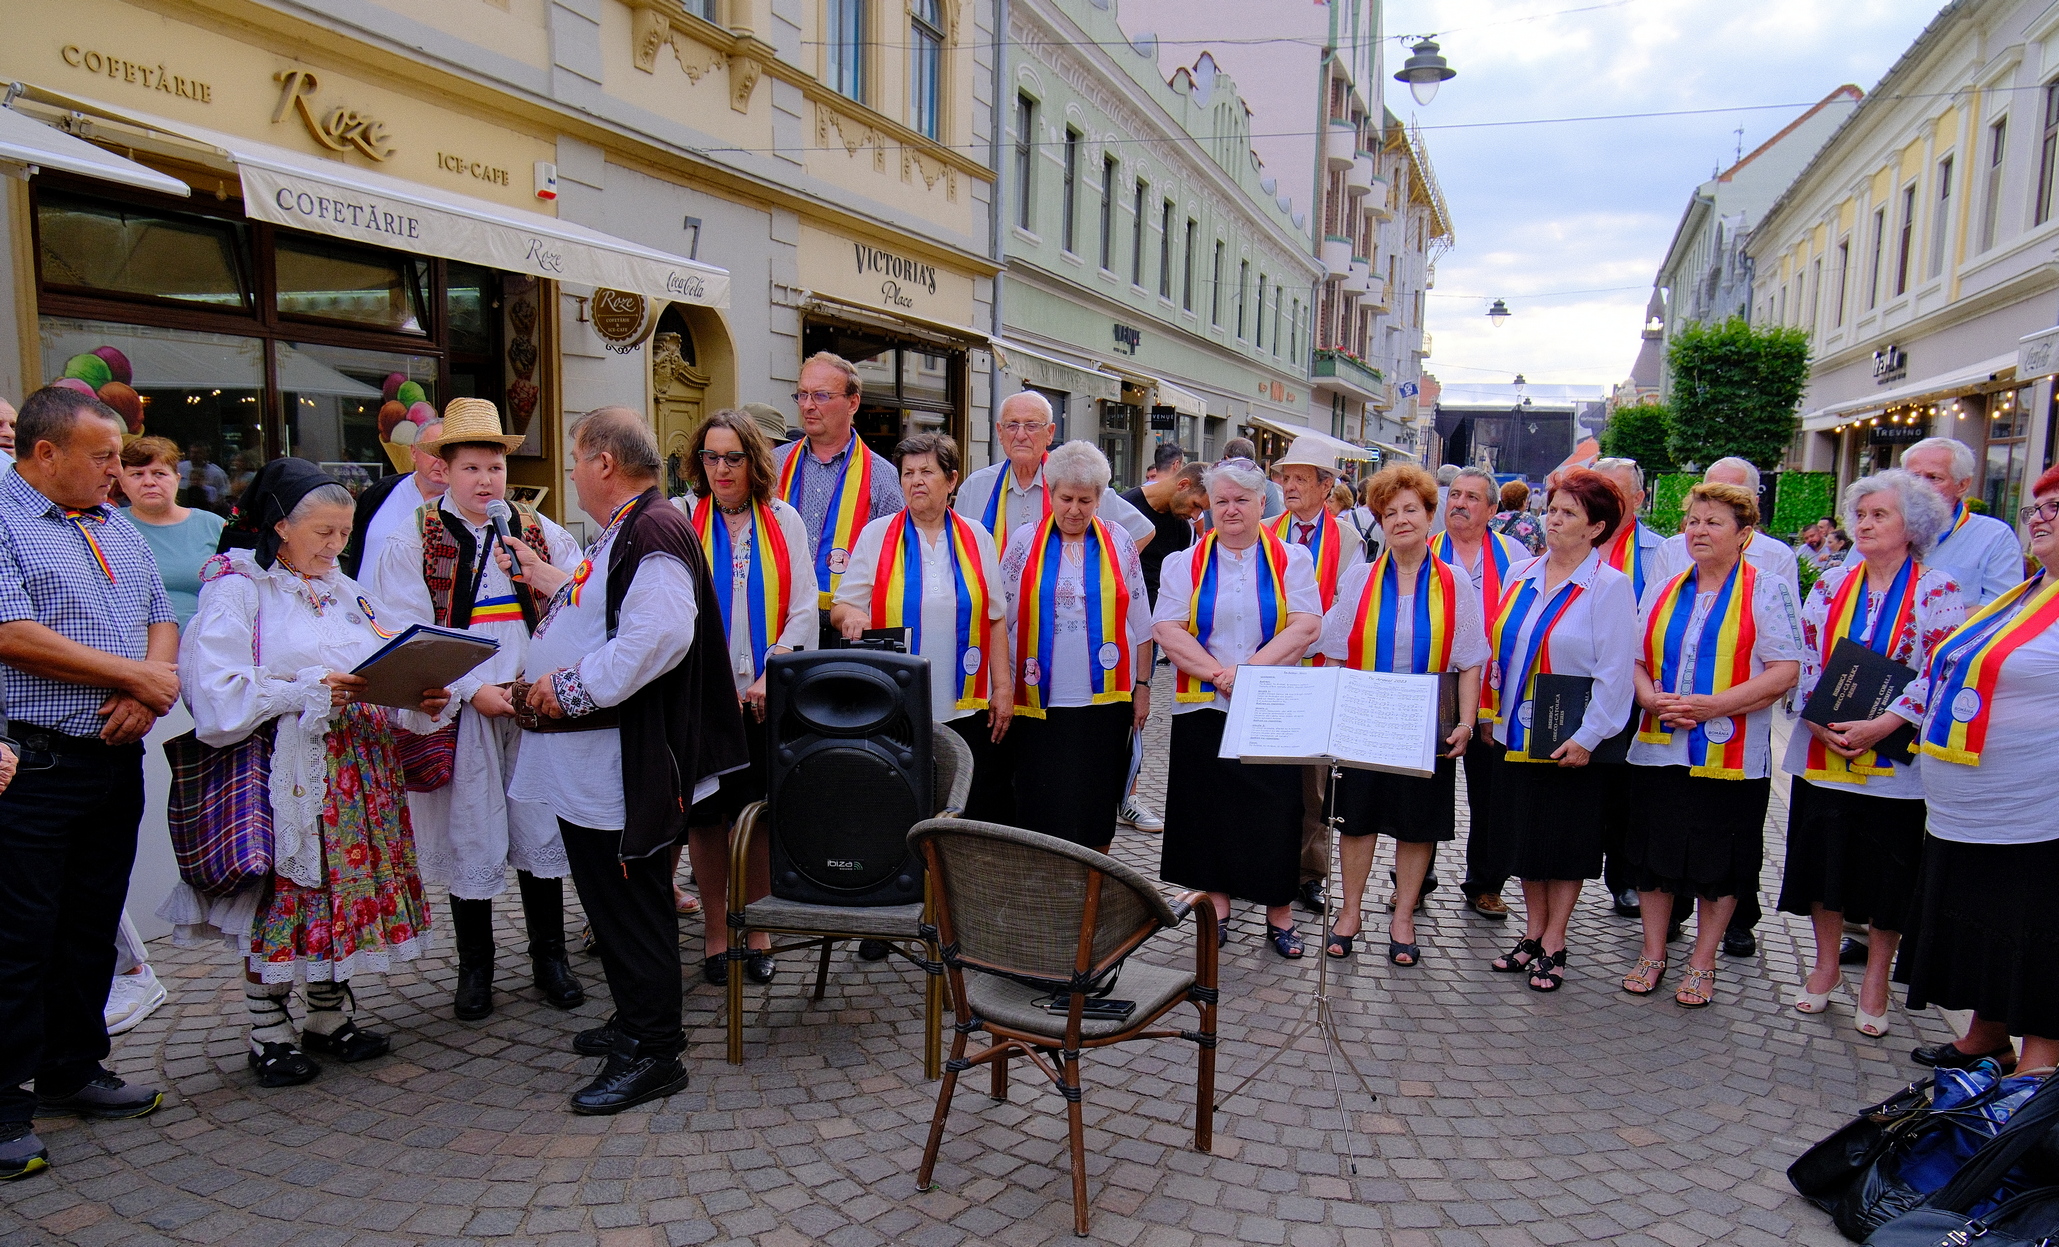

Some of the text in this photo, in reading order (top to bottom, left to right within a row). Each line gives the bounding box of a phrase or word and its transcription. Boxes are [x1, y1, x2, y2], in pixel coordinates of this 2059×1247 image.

[271, 70, 397, 162] Roze
[437, 152, 509, 186] ICE-CAFE
[276, 187, 420, 239] COFETĂRIE
[683, 216, 702, 260] 7
[525, 238, 564, 273] Roze
[854, 243, 936, 295] VICTORIA'S
[600, 290, 636, 312] Roze
[881, 280, 913, 308] Place
[1152, 413, 1174, 421] VENUE
[827, 859, 853, 867] ibiza
